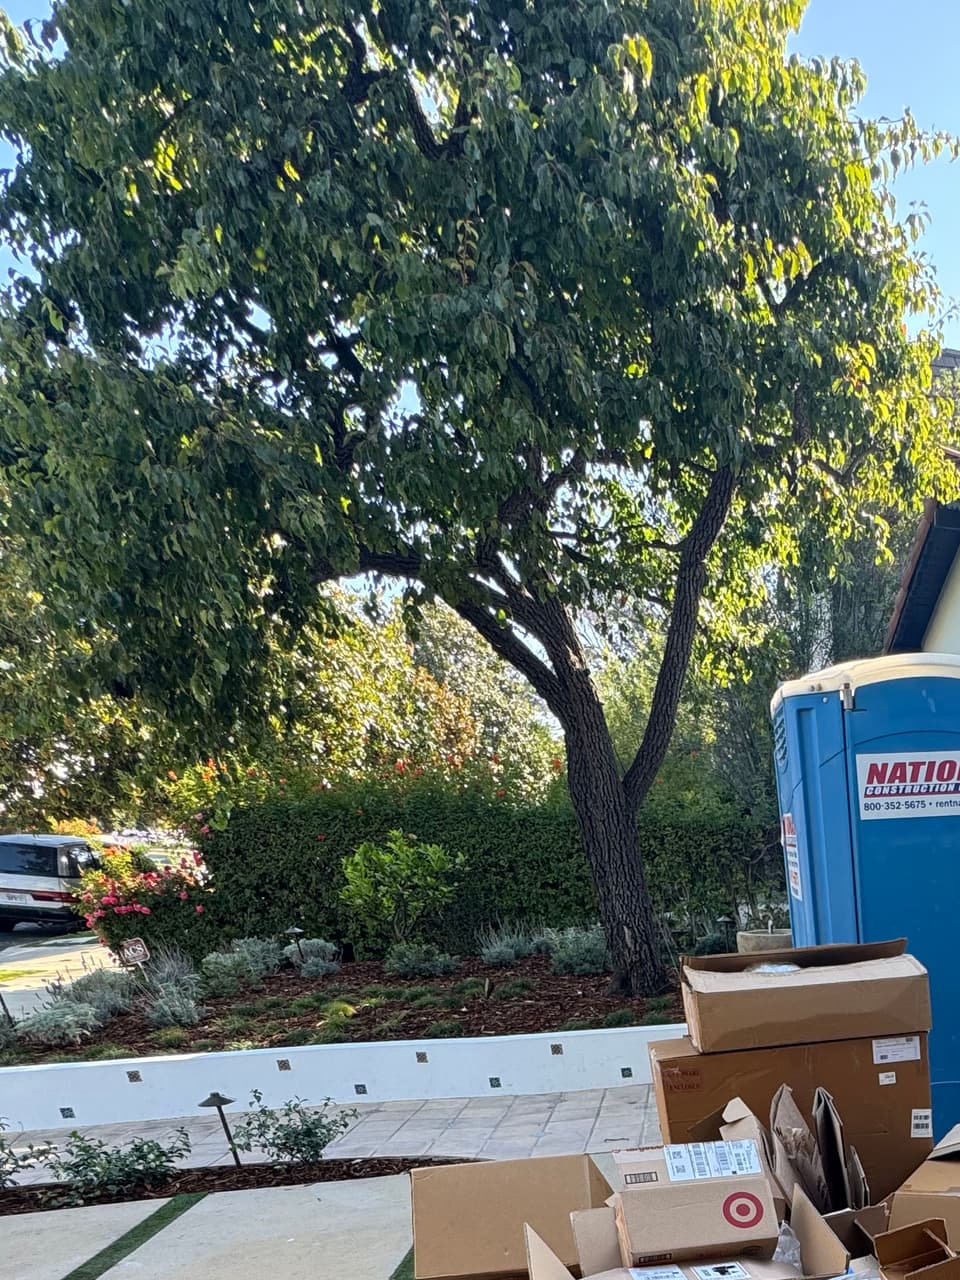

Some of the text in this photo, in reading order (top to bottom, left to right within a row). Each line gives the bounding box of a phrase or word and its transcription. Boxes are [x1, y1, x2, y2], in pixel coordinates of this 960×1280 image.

[866, 782, 958, 796] CONSTRUCTION
[863, 800, 927, 811] 800-352-5675
[123, 943, 144, 957] ACS
